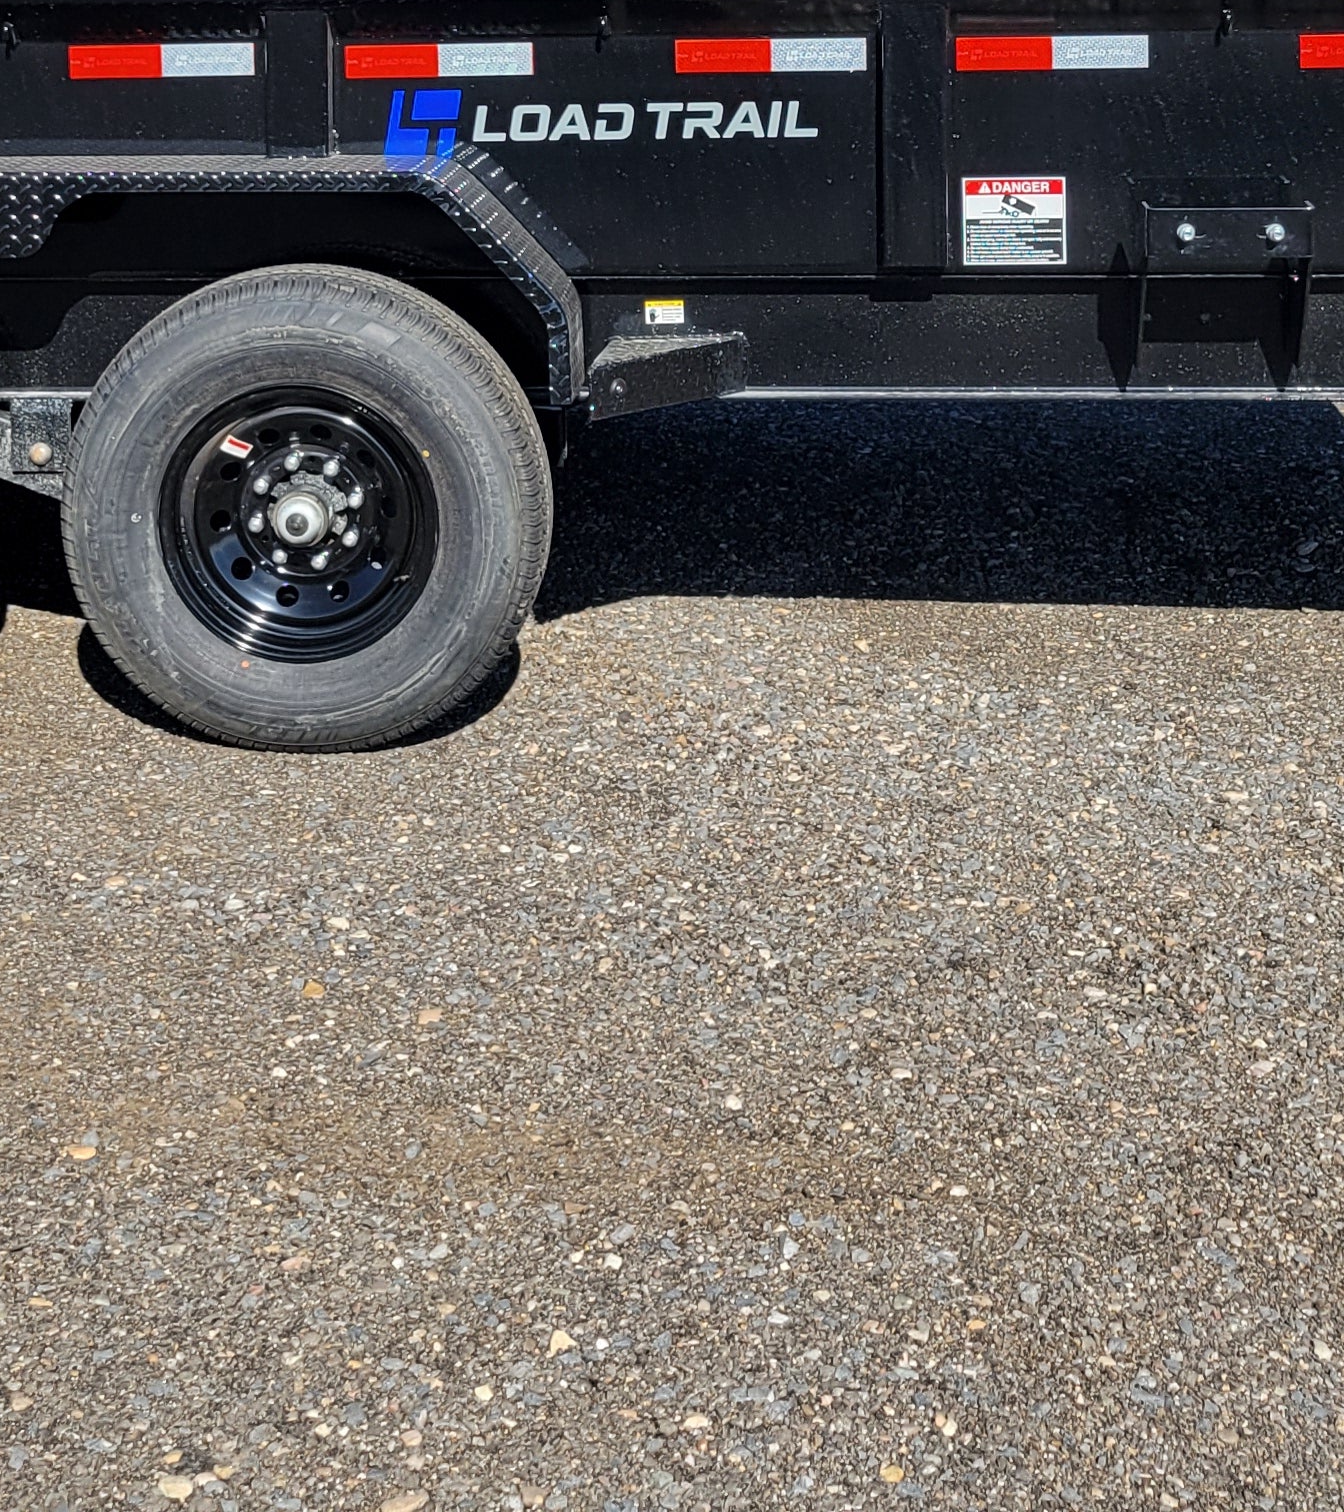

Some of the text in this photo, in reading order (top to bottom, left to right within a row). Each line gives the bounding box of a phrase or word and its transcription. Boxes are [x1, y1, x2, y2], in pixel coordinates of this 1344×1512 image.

[472, 100, 819, 142] LOAD TRAIL
[992, 182, 1050, 193] DANGER
